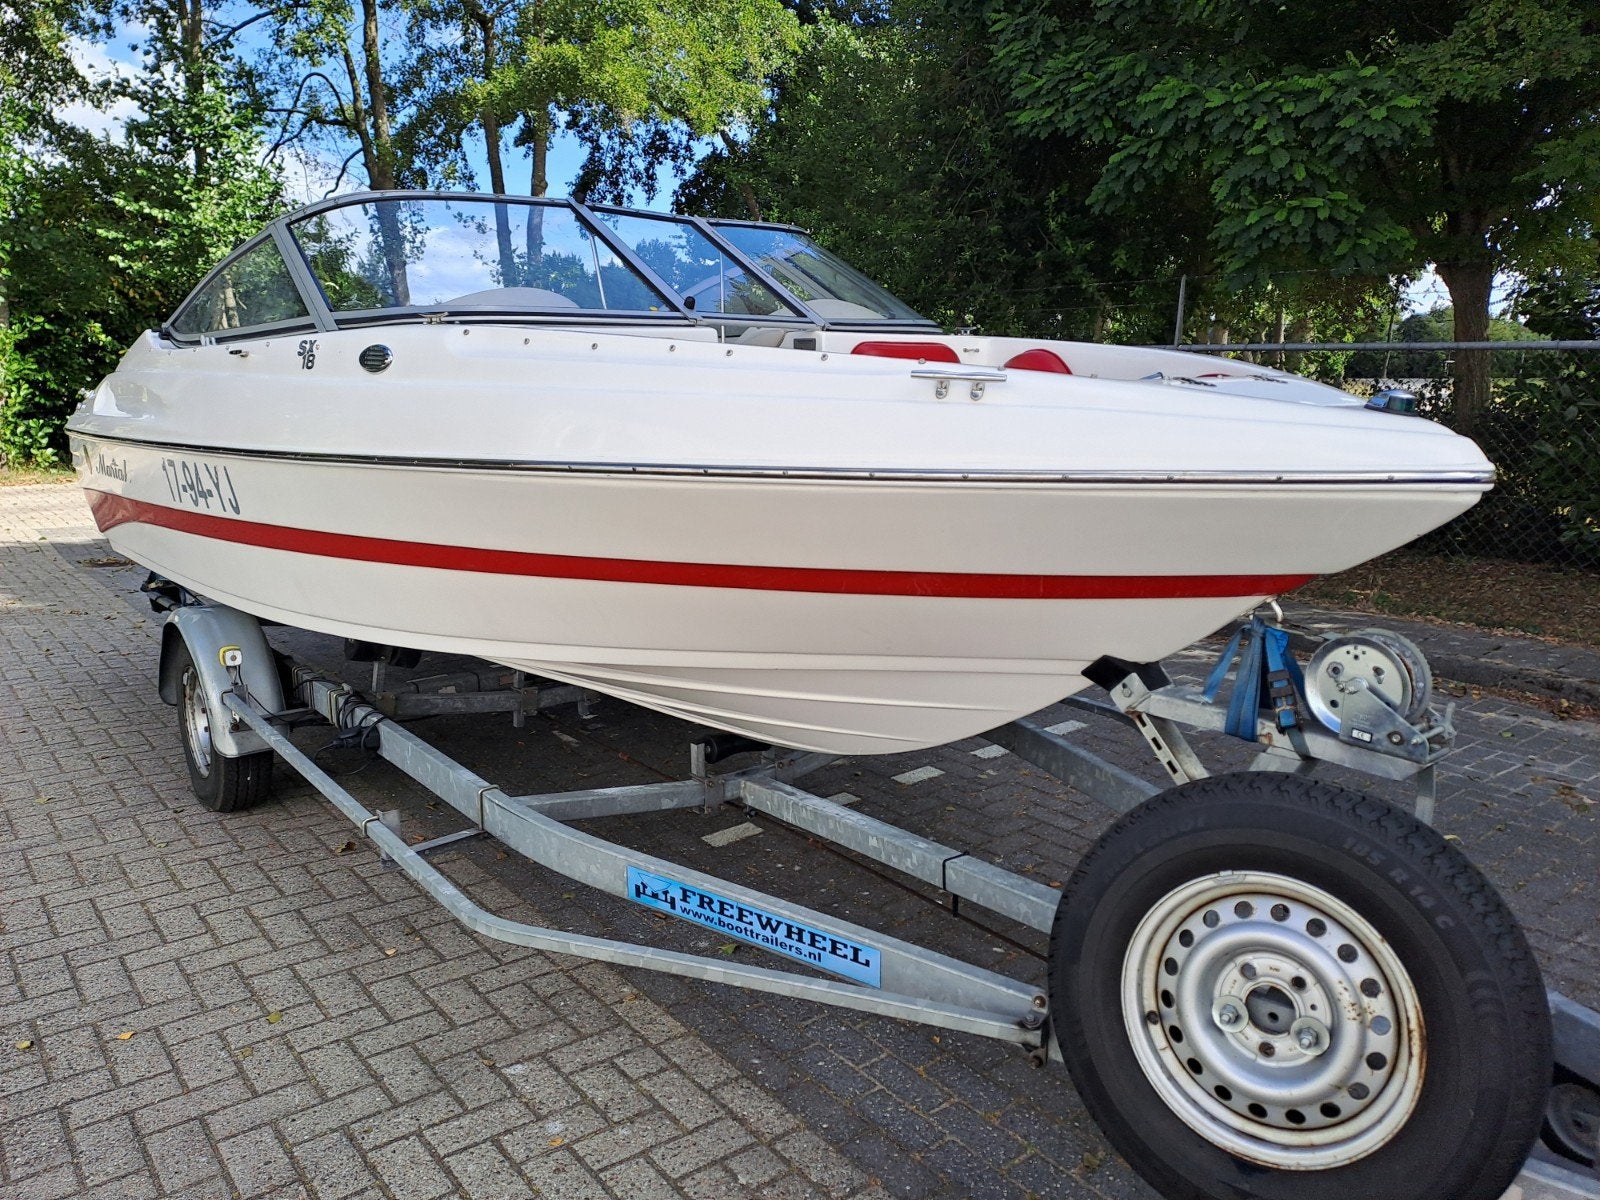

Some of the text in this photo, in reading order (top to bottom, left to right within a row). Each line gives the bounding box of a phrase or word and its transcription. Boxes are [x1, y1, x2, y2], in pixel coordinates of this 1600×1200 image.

[302, 354, 316, 370] 18
[679, 886, 870, 968] FREEWHEEL
[679, 904, 822, 963] www.boottrailers.nl
